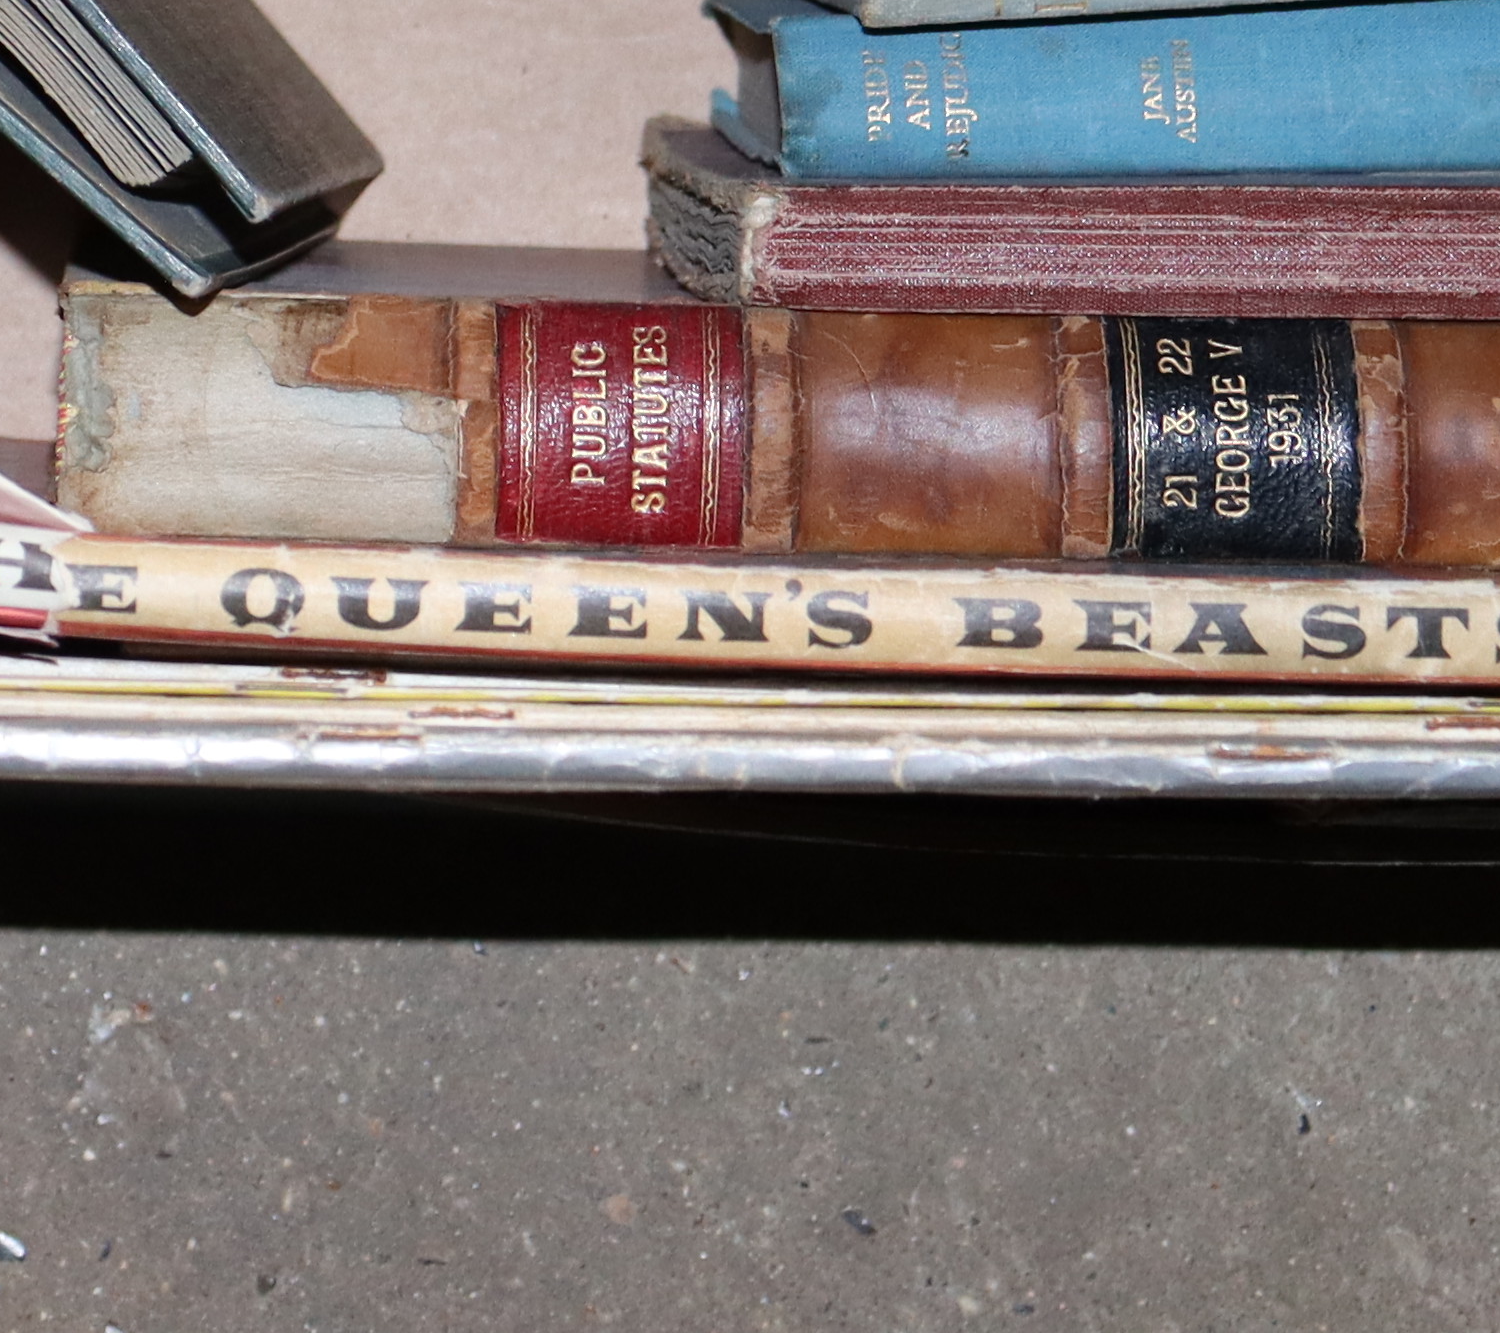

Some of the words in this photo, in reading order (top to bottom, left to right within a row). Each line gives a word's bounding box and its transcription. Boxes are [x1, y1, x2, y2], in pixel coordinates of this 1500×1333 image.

[905, 58, 931, 131] AND
[1140, 54, 1171, 126] JANE
[1170, 39, 1200, 144] AUSTEN
[1155, 337, 1194, 376] 22
[1207, 338, 1243, 359] V
[570, 340, 607, 486] PUBLIC
[630, 325, 669, 514] STATUTES
[1162, 405, 1197, 435] &
[1211, 374, 1251, 518] GEORGE
[1266, 393, 1303, 470] 1931
[1161, 474, 1198, 510] 21
[218, 561, 875, 651] QUEEN'S
